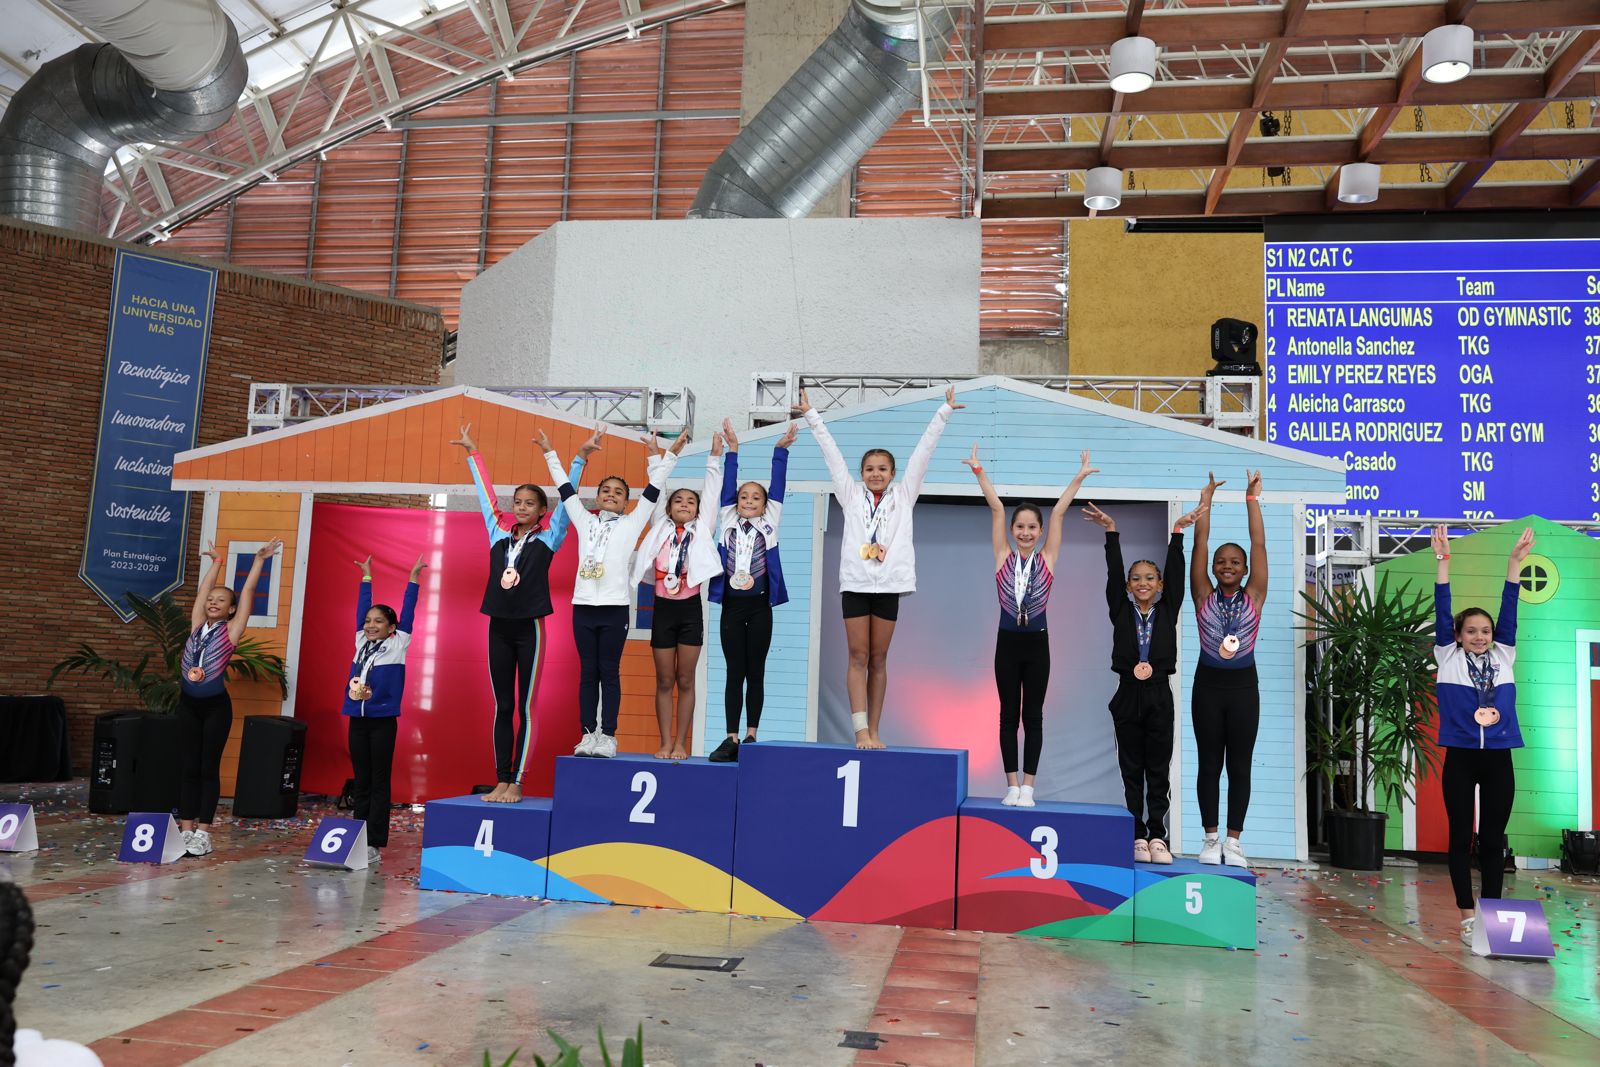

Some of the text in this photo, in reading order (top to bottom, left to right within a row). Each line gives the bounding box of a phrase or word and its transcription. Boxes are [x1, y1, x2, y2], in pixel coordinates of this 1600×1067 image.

[1266, 247, 1353, 267] S1 N2 CAT C
[1267, 279, 1285, 297] PL
[1286, 278, 1325, 296] Name
[1457, 277, 1495, 296] Team
[131, 294, 196, 315] HACIA UNA
[122, 305, 203, 328] UNIVERSIDAD
[1267, 308, 1274, 327] 1
[1287, 308, 1346, 327] RENATA
[1350, 307, 1433, 327] LANGUMAS
[1458, 307, 1480, 326] OD
[1484, 306, 1572, 326] GYMNASTIC
[148, 322, 175, 336] MÁS
[1267, 337, 1276, 356] 2
[1287, 336, 1352, 356] Antonella
[1356, 336, 1415, 356] Sanchez
[1458, 336, 1490, 355] TKG
[117, 360, 191, 389] Tecnológica
[1268, 366, 1276, 384] 3
[1287, 365, 1332, 384] EMILY
[1335, 365, 1384, 384] PEREZ
[1387, 365, 1437, 384] REYES
[1459, 365, 1494, 384] OGA
[1268, 394, 1277, 413] 4
[1288, 393, 1339, 413] Aleicha
[1342, 393, 1406, 413] Carrasco
[1460, 394, 1492, 413] TKG
[111, 408, 186, 434] Innovadora
[1269, 423, 1277, 442] 5
[1288, 422, 1352, 442] GALILEA
[1355, 422, 1443, 442] RODRIGUEZ
[1461, 423, 1472, 442] D
[1475, 423, 1507, 442] ART
[1510, 423, 1544, 442] GYM
[114, 455, 173, 477] Inclusiva
[1344, 451, 1397, 471] Casado
[1461, 452, 1493, 472] TKG
[1463, 481, 1485, 501] SM
[105, 501, 171, 523] Sostenible
[103, 549, 167, 562] Plan Estratégico
[110, 560, 160, 572] 2023-2028
[629, 771, 657, 824] 2
[837, 760, 860, 828] 1
[131, 823, 154, 852] 8
[320, 827, 347, 854] 6
[474, 819, 494, 857] 4
[1030, 826, 1059, 880] 3
[1185, 882, 1203, 915] 5
[1496, 910, 1528, 943] 7
